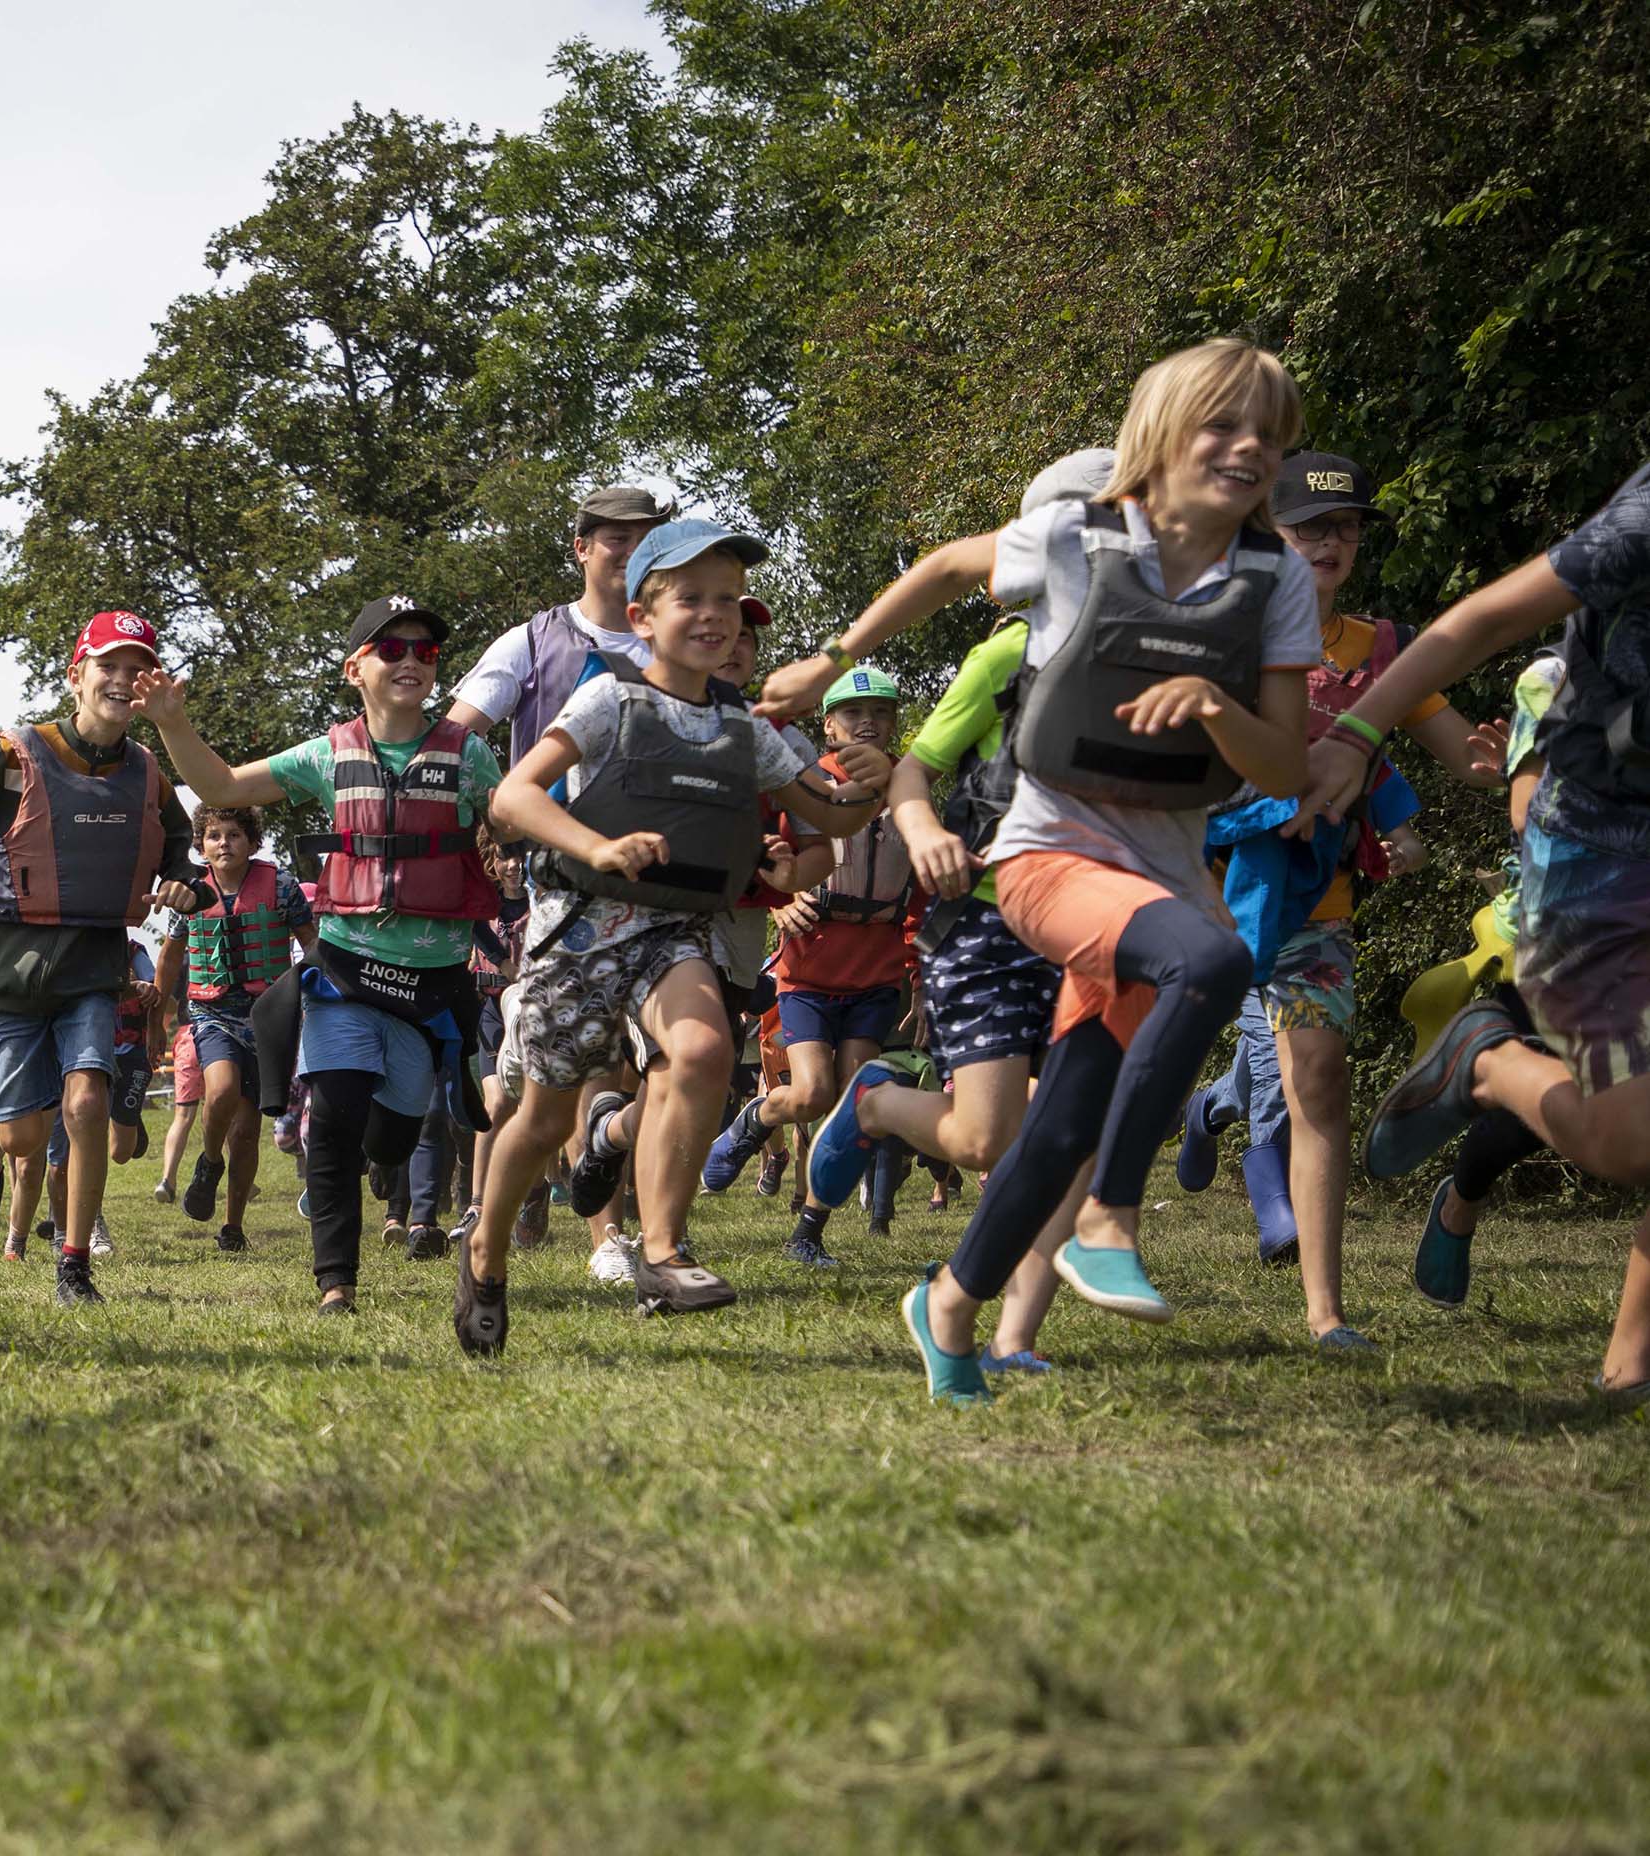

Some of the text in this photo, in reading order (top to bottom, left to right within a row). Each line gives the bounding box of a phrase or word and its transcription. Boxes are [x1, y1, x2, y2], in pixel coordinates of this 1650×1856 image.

[1307, 471, 1326, 482] DY
[1307, 481, 1328, 492] TG
[421, 768, 446, 784] HH
[360, 961, 420, 987] FRONT
[359, 976, 415, 1001] INSIDE
